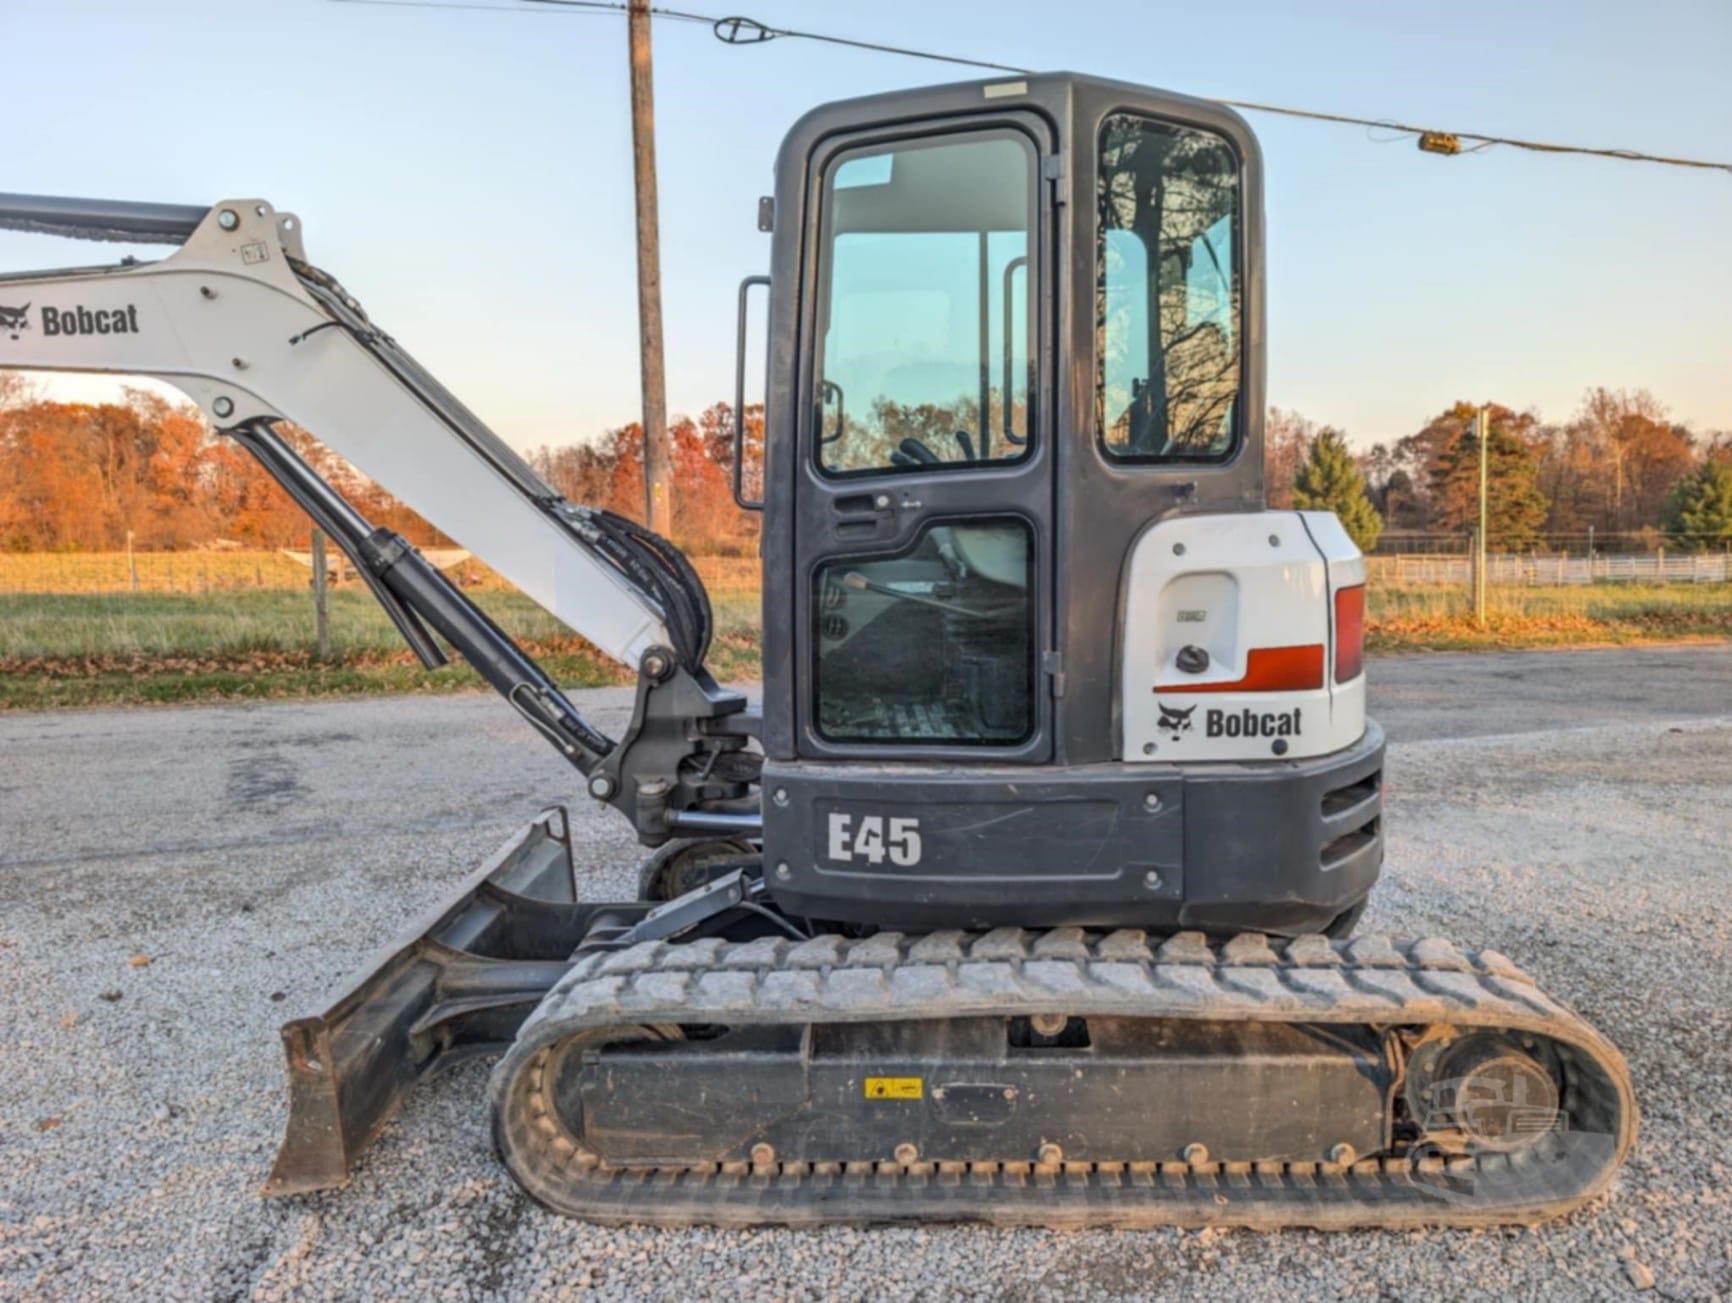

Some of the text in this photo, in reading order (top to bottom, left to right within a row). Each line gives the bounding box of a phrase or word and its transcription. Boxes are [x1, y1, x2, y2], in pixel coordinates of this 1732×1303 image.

[41, 304, 139, 336] Bobcat
[1206, 708, 1302, 738] Bobcat
[828, 813, 922, 867] E45
